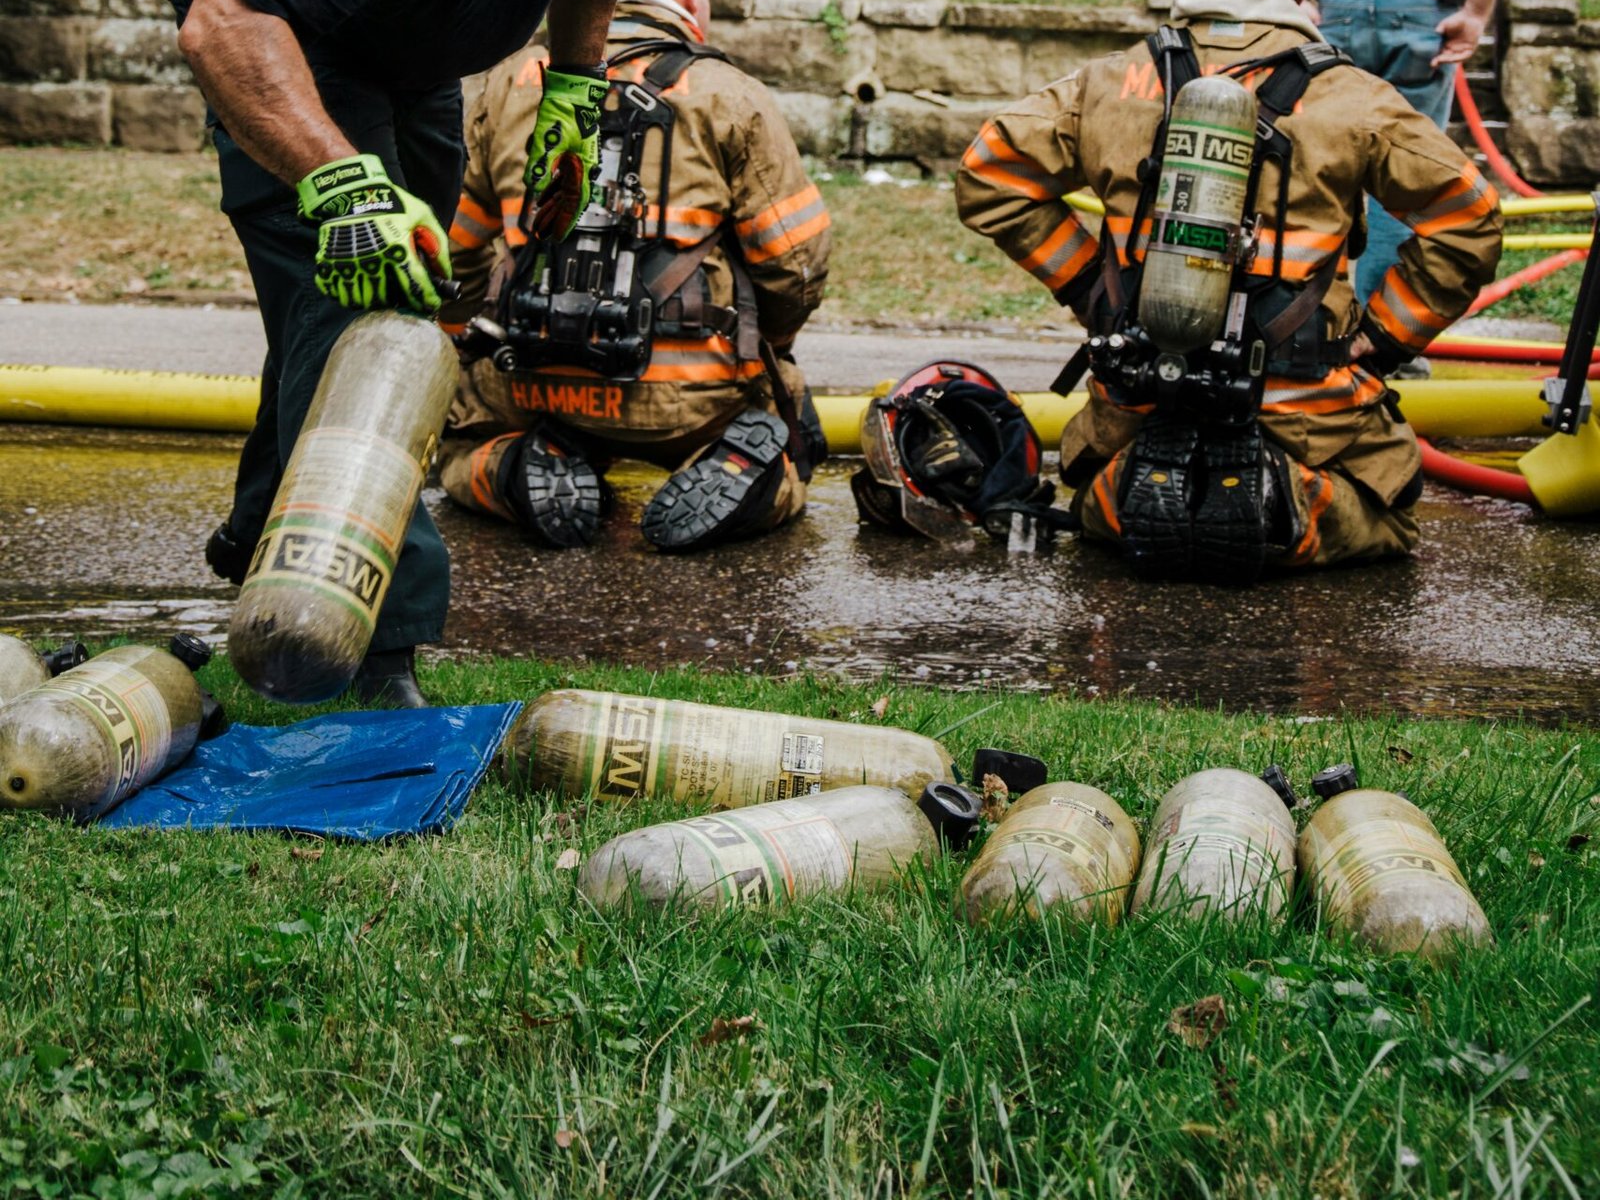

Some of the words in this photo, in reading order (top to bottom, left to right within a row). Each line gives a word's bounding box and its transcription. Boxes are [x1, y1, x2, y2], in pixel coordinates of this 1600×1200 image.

[1165, 220, 1227, 249] MSA
[511, 382, 623, 419] HAMMER
[284, 537, 380, 600] MSA
